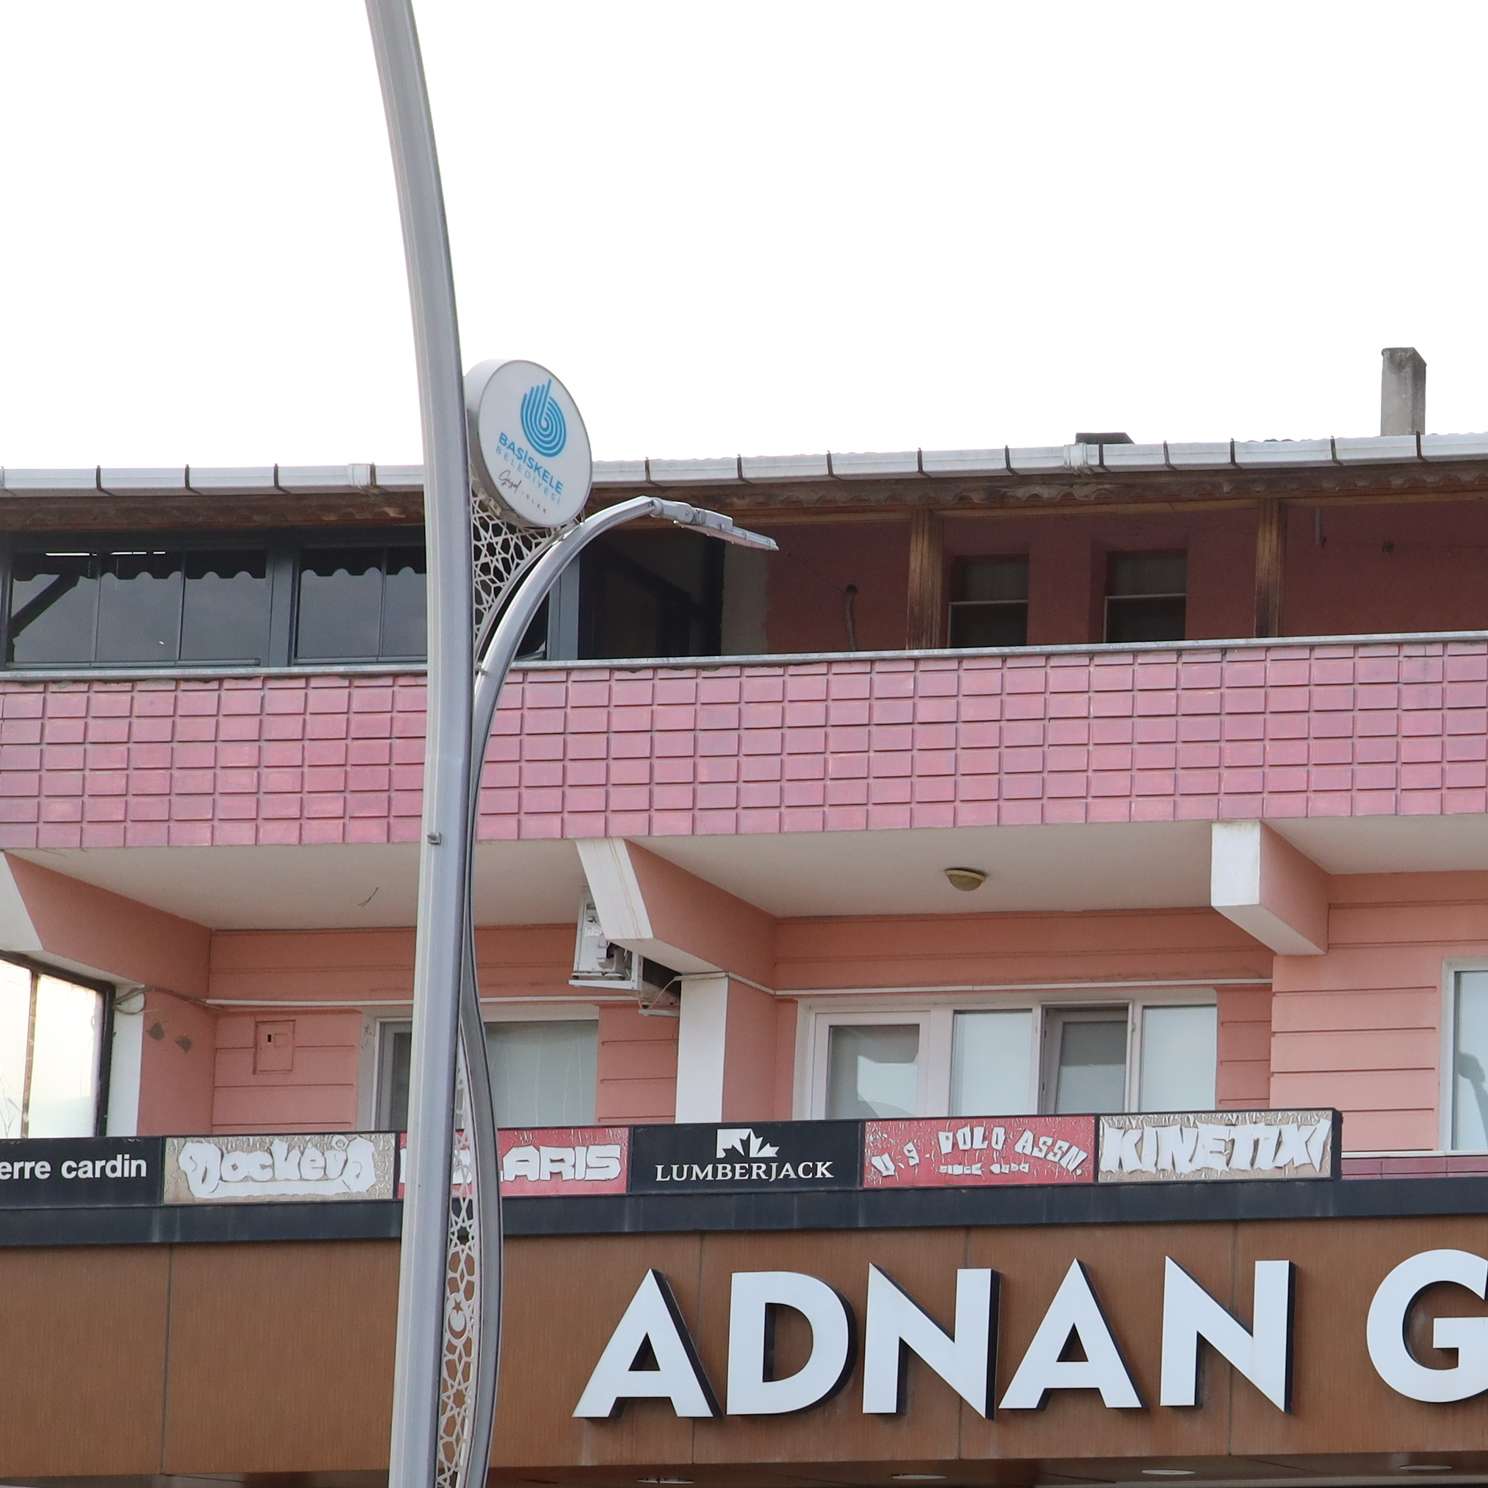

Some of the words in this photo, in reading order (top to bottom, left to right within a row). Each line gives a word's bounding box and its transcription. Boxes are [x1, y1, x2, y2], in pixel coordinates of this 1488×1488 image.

[938, 1125, 1006, 1155] POLO
[61, 1153, 147, 1179] cardin
[655, 1160, 834, 1183] LUMBERJACK
[574, 1255, 1292, 1419] ADNAN
